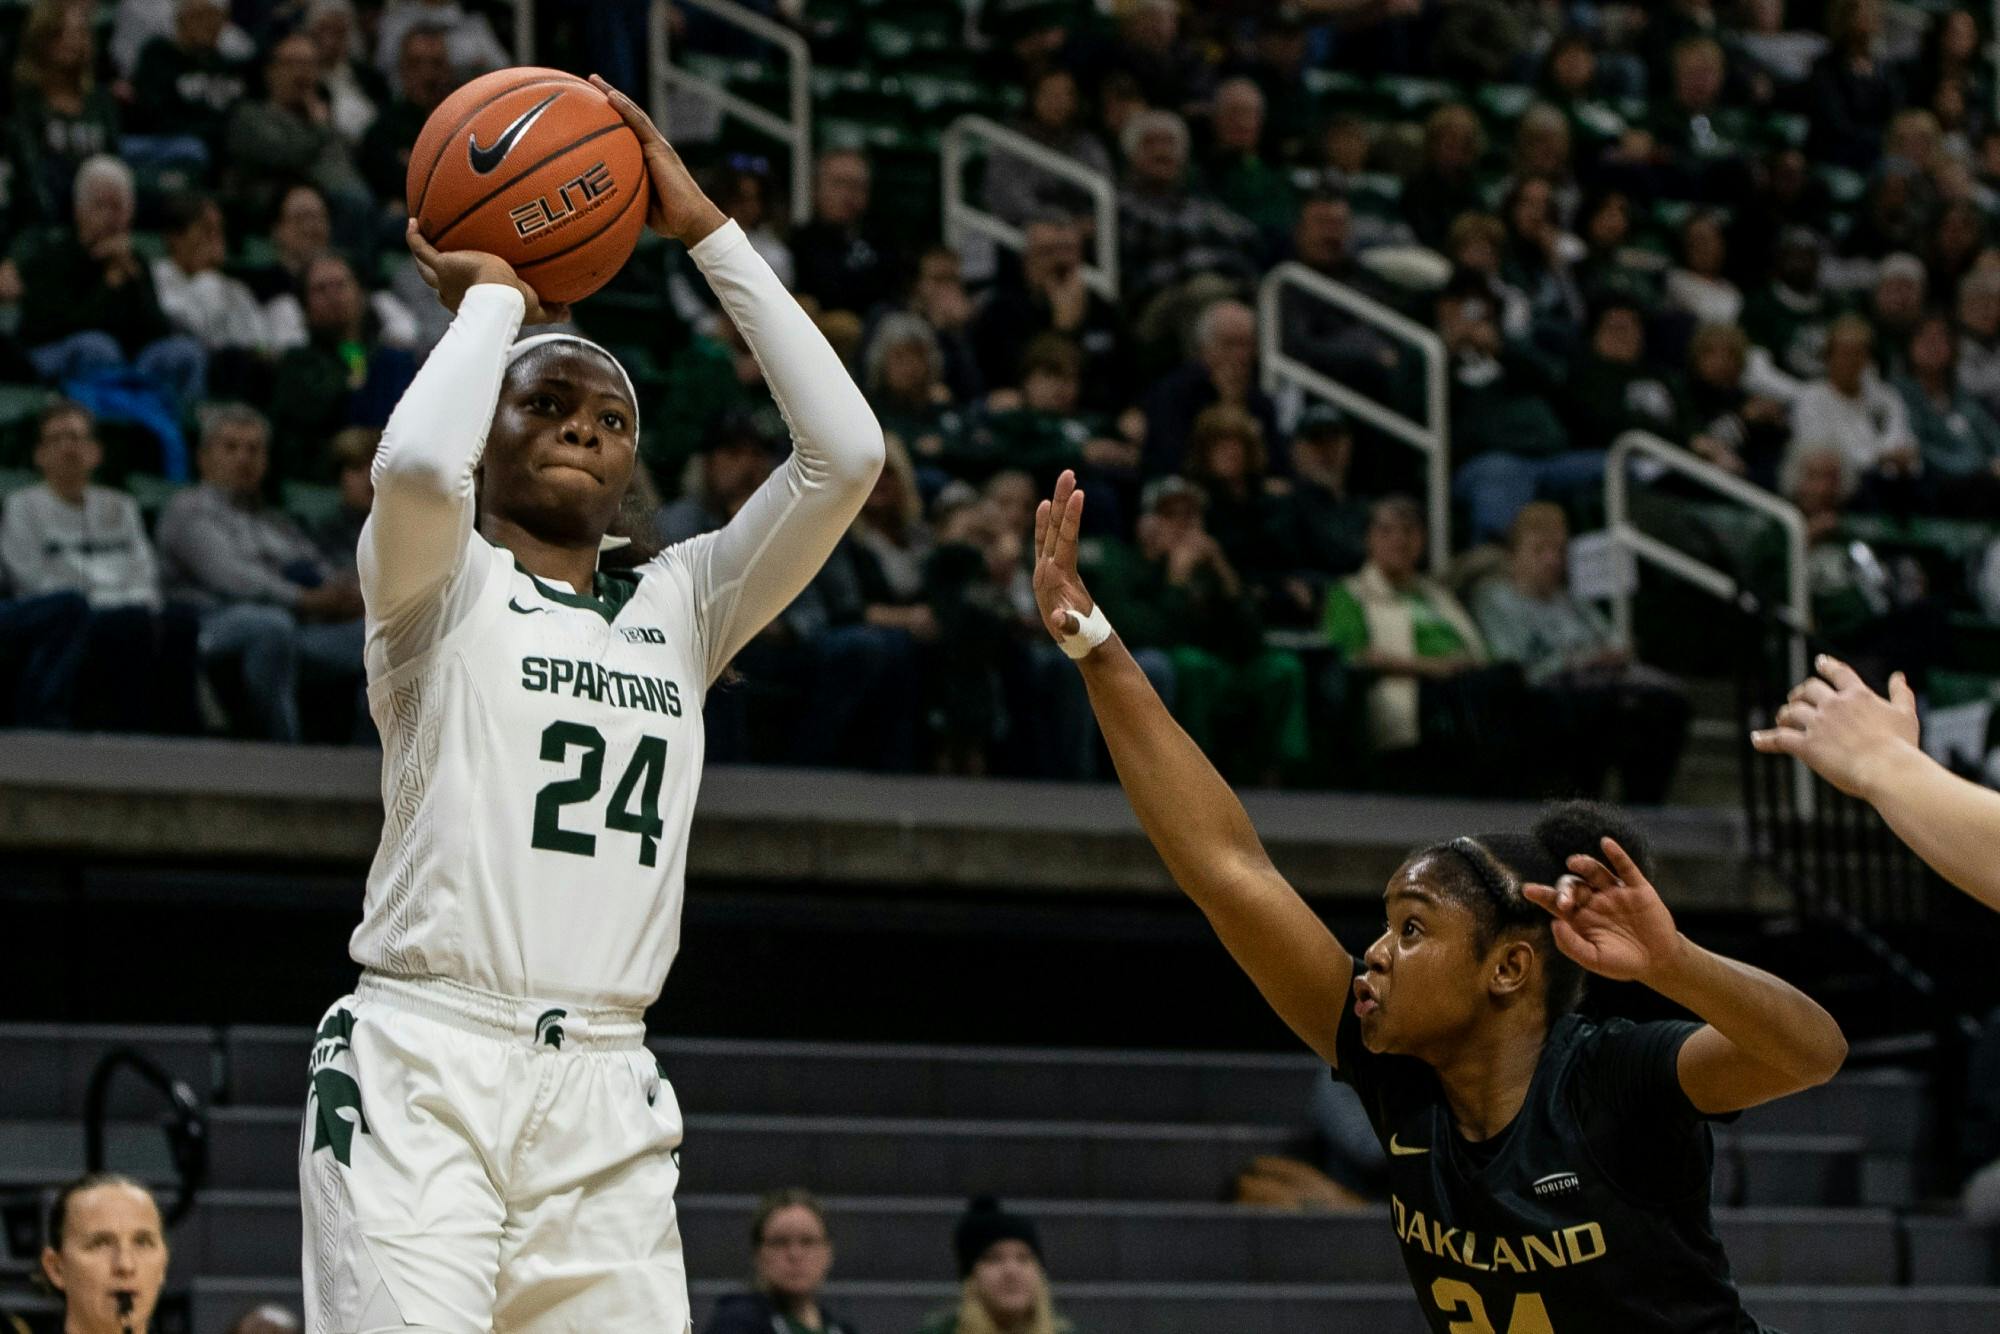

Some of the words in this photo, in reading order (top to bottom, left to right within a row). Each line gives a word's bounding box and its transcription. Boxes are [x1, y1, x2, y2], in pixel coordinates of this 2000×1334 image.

[509, 161, 616, 238] ELITE
[522, 656, 682, 718] SPARTANS
[531, 720, 668, 868] 24
[1534, 1176, 1579, 1195] HORIZON
[1392, 1194, 1607, 1273] OAKLAND
